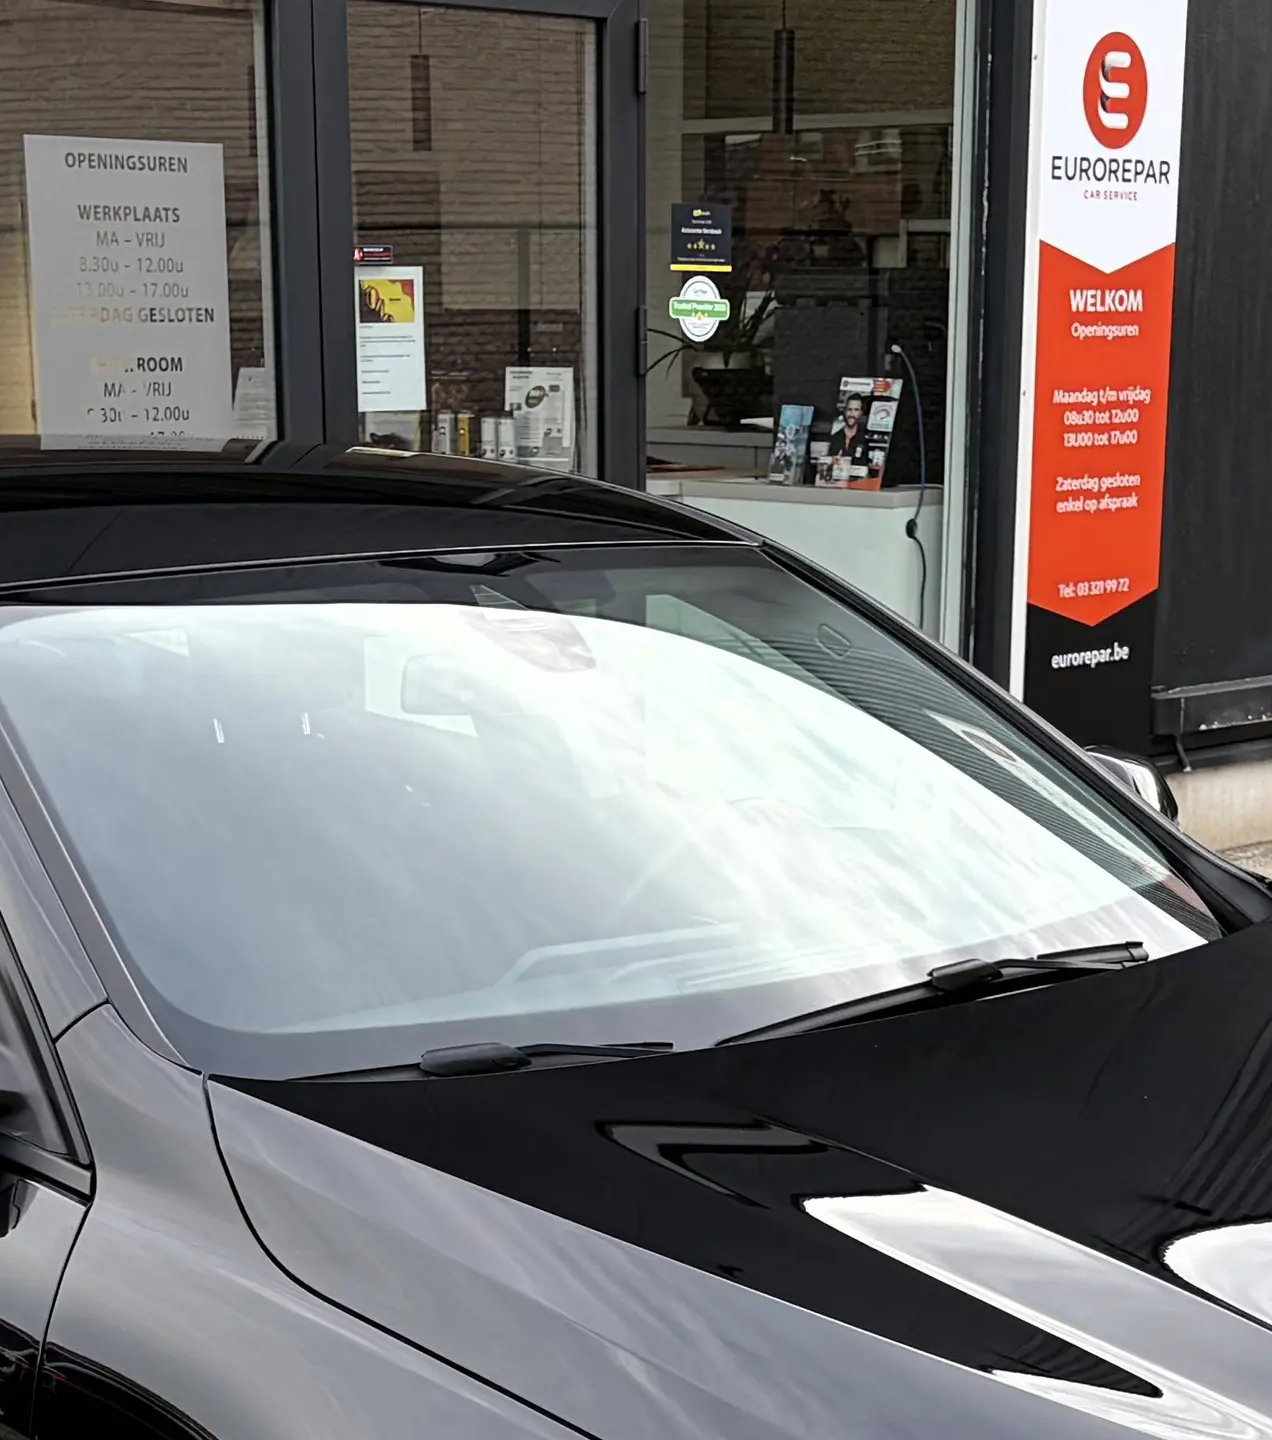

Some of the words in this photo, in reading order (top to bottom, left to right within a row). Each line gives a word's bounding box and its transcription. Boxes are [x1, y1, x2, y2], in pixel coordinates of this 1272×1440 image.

[64, 152, 189, 174] OPENINGSUREN
[1050, 155, 1172, 185] EUROREPAR
[1083, 189, 1101, 200] CAR
[1103, 190, 1138, 201] SERVICE
[77, 203, 181, 224] WERKPLAATS
[96, 230, 120, 247] MA
[135, 231, 166, 249] VRIJ
[137, 257, 184, 273] 12.00u
[142, 282, 189, 298] 17.00u
[1069, 288, 1144, 313] WELKOM
[138, 307, 215, 323] GESLOTEN
[1070, 321, 1140, 341] Openingsuren
[1052, 387, 1098, 406] Maandag
[1099, 386, 1118, 405] t/m
[1118, 385, 1151, 405] vrijdag
[144, 406, 190, 421] 12.00u
[1095, 410, 1110, 424] tot
[1094, 432, 1108, 446] tot
[1055, 474, 1098, 493] Zaterdag
[1100, 472, 1141, 491] gesloten
[1056, 497, 1083, 513] enkel
[1084, 499, 1097, 514] op
[1098, 492, 1139, 511] afspraak
[1058, 582, 1076, 598] Tel:
[1076, 581, 1089, 597] 03
[1105, 579, 1117, 593] 99
[1118, 578, 1130, 592] 72
[1050, 641, 1130, 669] eurorepar.be
